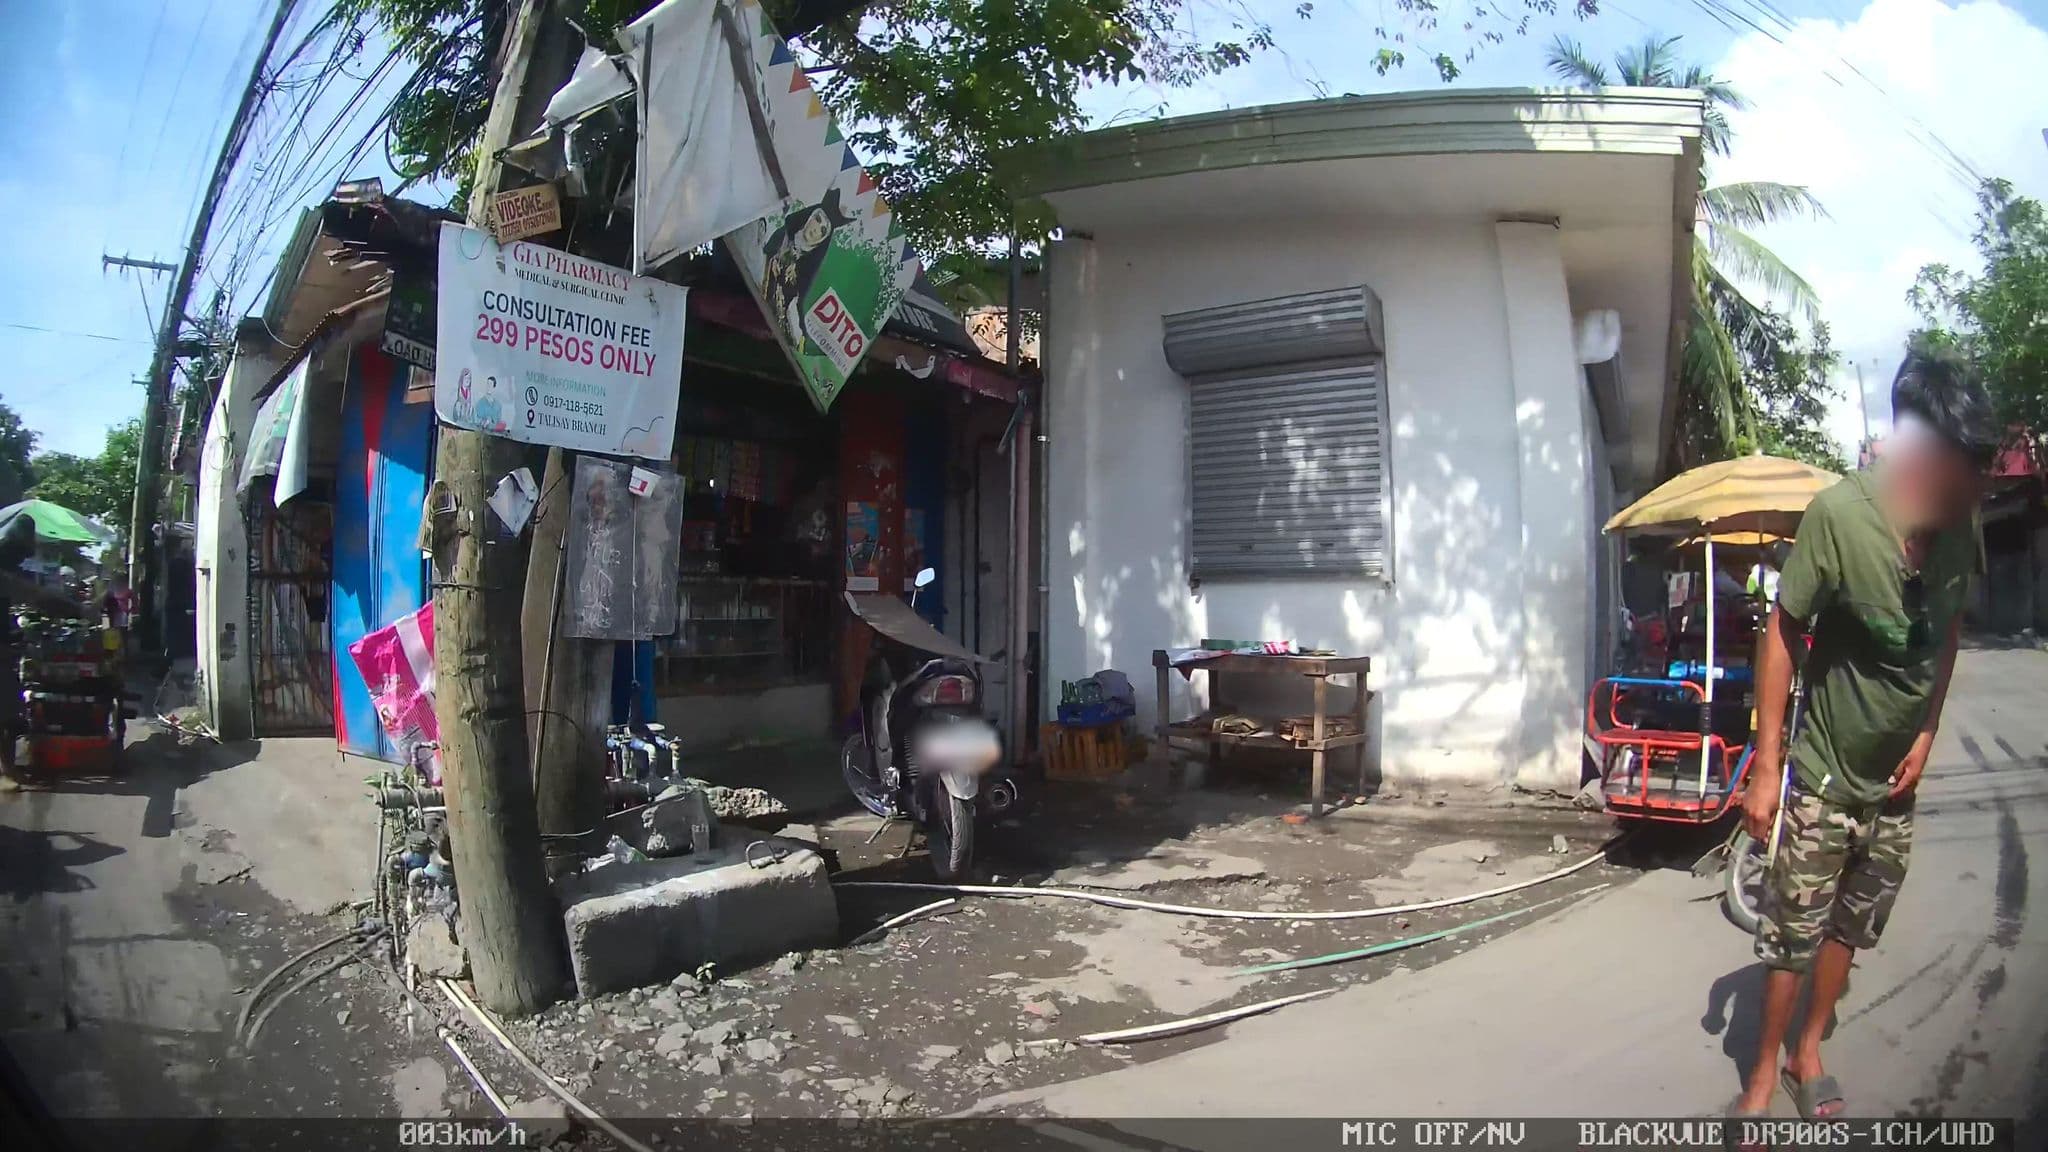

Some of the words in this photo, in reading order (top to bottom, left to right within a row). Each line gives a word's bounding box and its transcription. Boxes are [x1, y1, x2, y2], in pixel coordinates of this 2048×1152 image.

[496, 192, 542, 223] VIDEOKE
[514, 243, 541, 267] GIA
[546, 252, 630, 291] PHARMACY
[515, 268, 550, 286] MEDICAL
[552, 279, 559, 288] &
[561, 280, 598, 298] SURGICAL
[600, 290, 626, 305] CLINIC
[483, 290, 616, 340] CONSULTATION
[621, 324, 651, 347] FEE
[813, 294, 863, 358] DITO
[476, 313, 518, 348] 299
[525, 325, 594, 365] PESOS
[600, 344, 656, 377] ONLY
[543, 395, 604, 416] 0917-118-5621
[551, 377, 606, 397] INFORMATION
[538, 412, 569, 430] TALISAY
[572, 420, 606, 436] BRANCH
